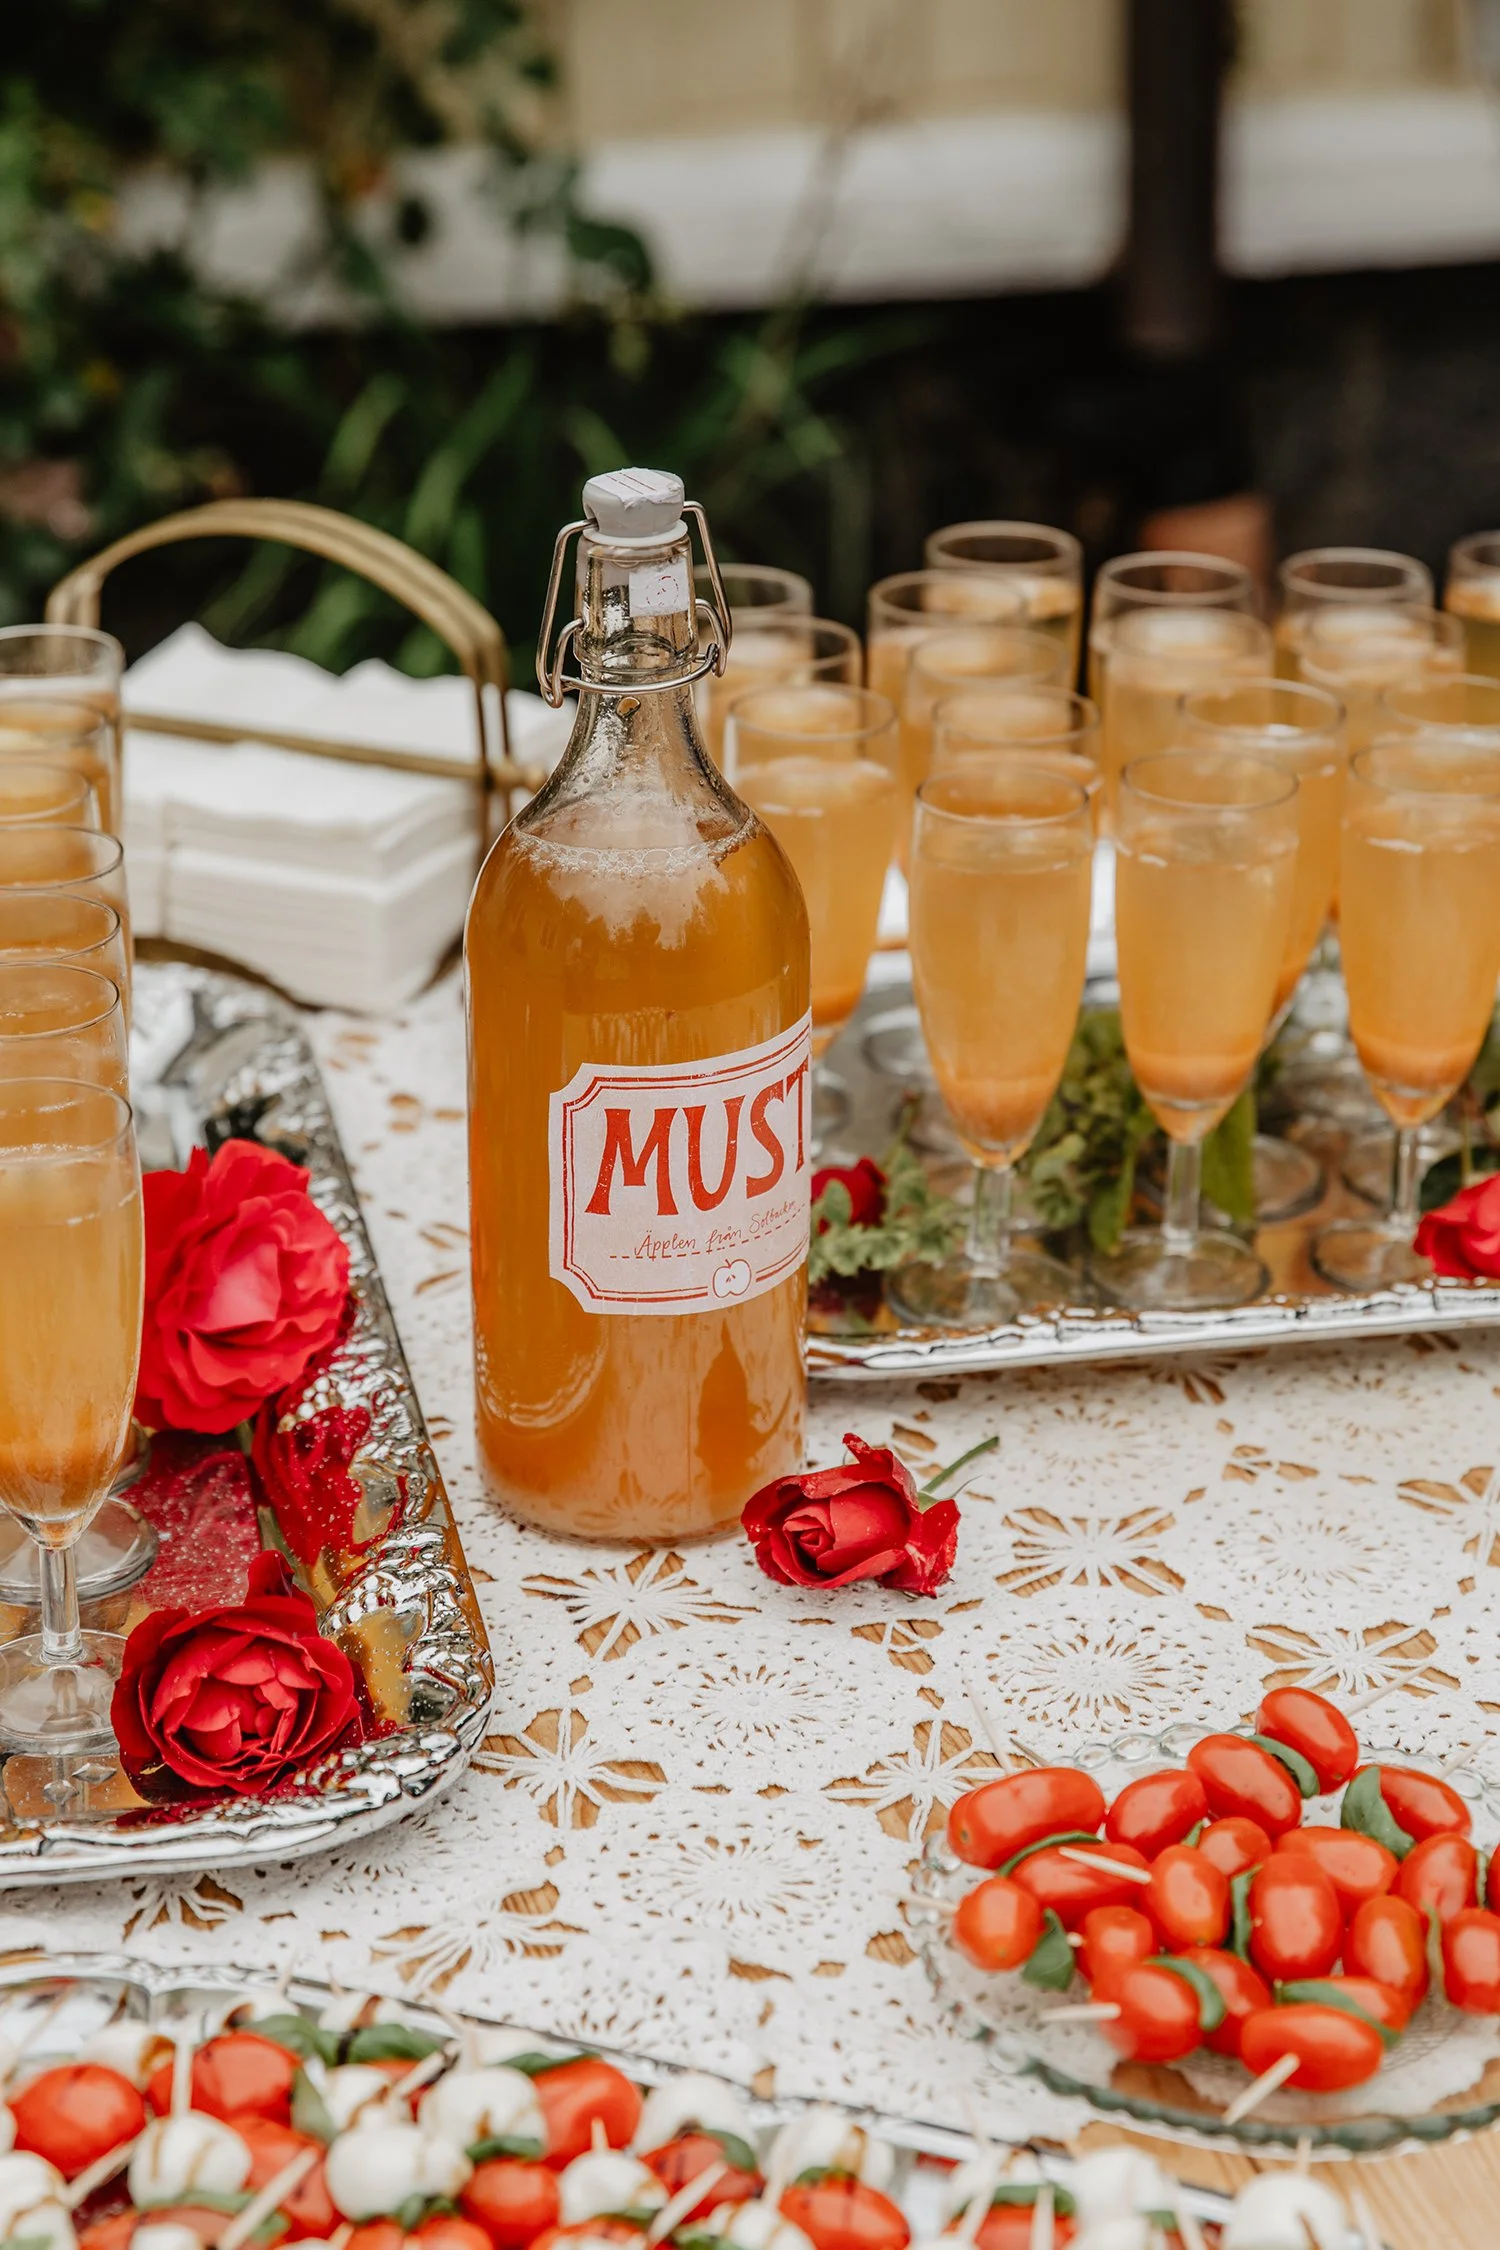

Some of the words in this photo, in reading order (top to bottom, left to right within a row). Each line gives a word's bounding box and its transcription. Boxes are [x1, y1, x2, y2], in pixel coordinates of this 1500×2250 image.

[585, 1055, 808, 1215] MUST
[634, 1230, 695, 1261] Äpplen
[706, 1226, 741, 1254] från
